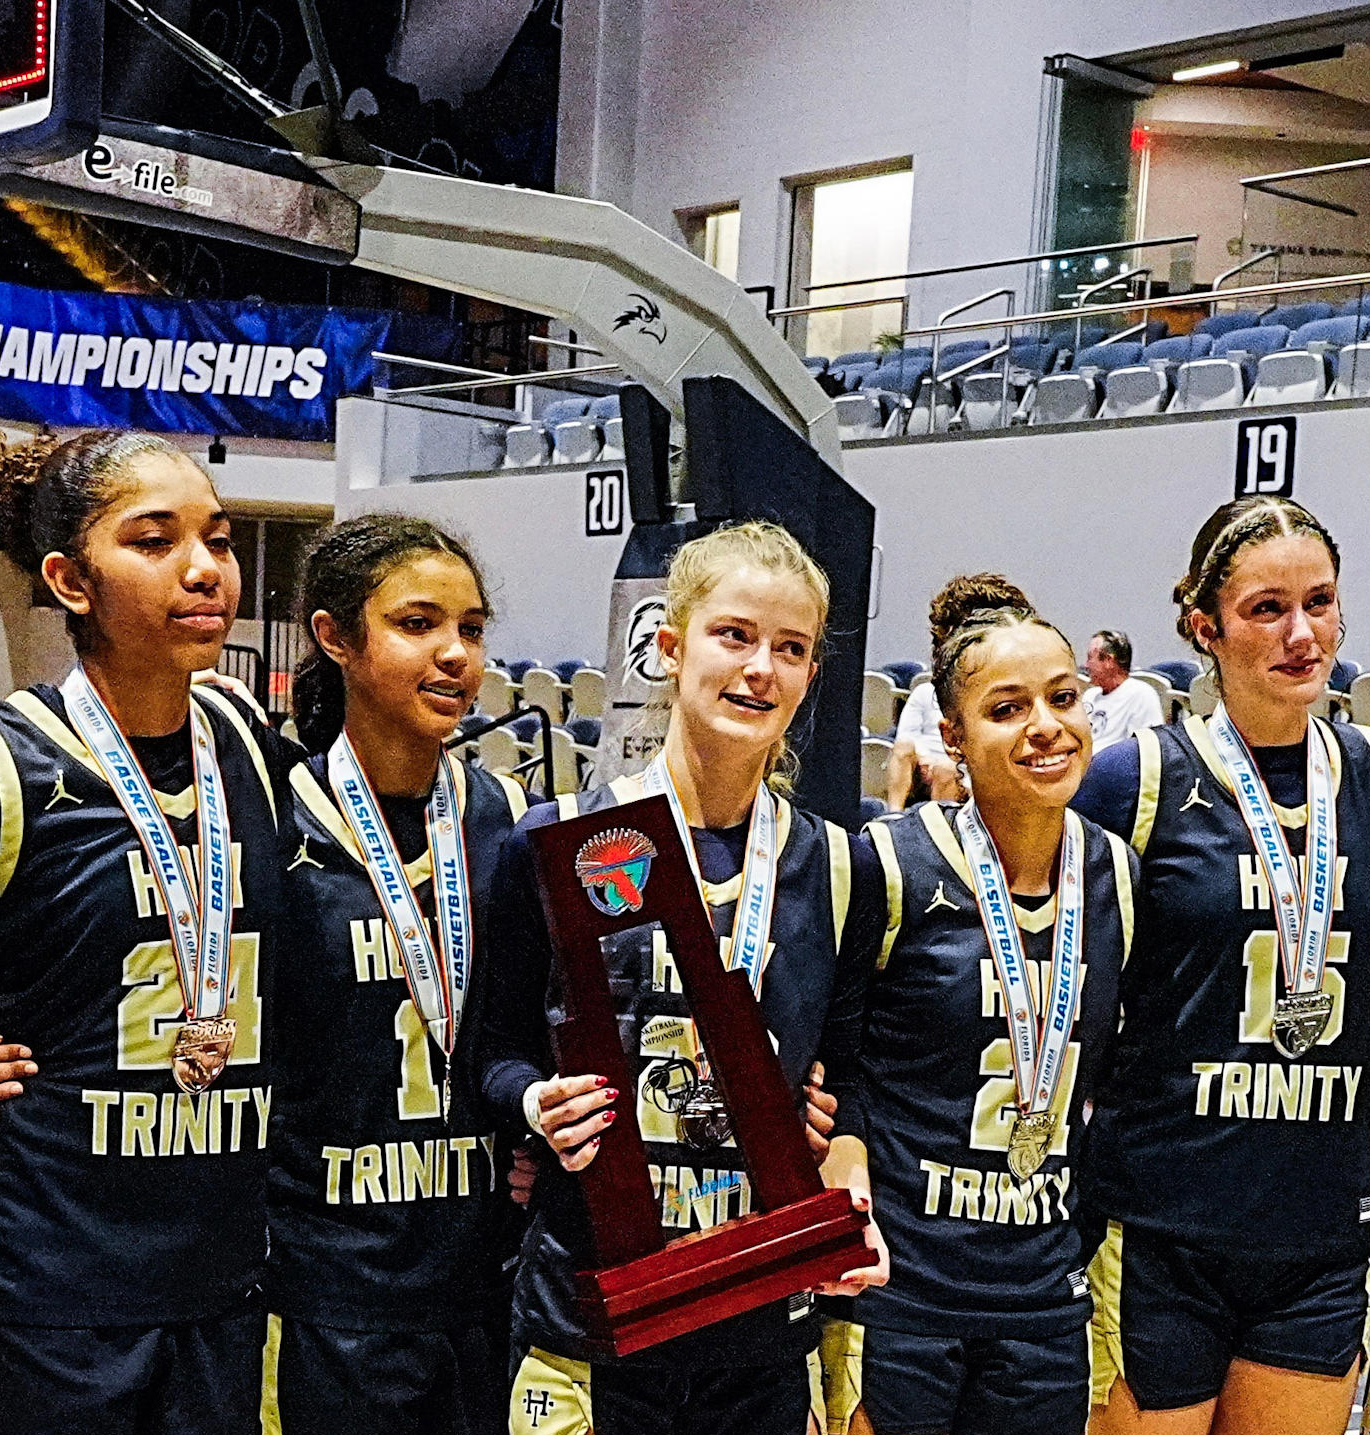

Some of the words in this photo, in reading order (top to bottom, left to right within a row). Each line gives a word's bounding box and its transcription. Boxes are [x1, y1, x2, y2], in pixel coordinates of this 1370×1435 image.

[1242, 423, 1289, 494] 19
[588, 475, 621, 531] 20
[78, 696, 105, 734] FLORIDA
[104, 750, 179, 886] BASKETBALL
[203, 772, 224, 913] BASKETBALL
[343, 778, 404, 904] BASKETBALL
[1232, 760, 1283, 872] BASKETBALL
[1312, 796, 1327, 914] BASKETBALL
[207, 931, 219, 974] FLORIDA
[444, 858, 463, 991] BASKETBALL
[979, 863, 1023, 986] BASKETBALL
[1306, 929, 1318, 967] FLORIDA
[412, 943, 430, 981] FLORIDA
[1053, 907, 1075, 1034] BASKETBALL
[1020, 1025, 1031, 1063] FLORIDA
[1042, 1047, 1056, 1086] FLORIDA
[82, 1085, 273, 1157] TRINITY
[1191, 1062, 1364, 1122] TRINITY
[322, 1132, 497, 1205] TRINITY
[919, 1159, 1071, 1225] TRINITY
